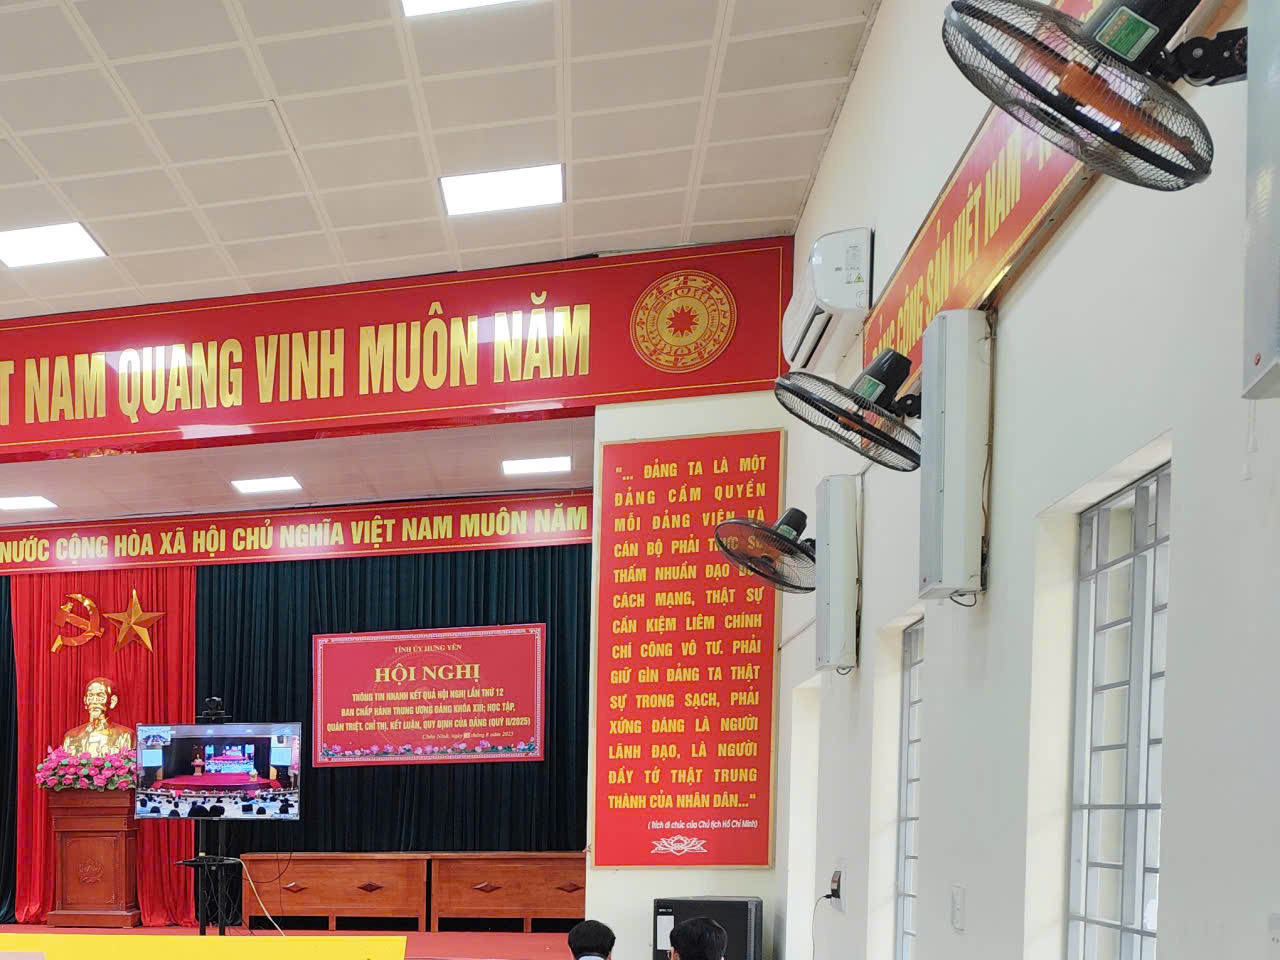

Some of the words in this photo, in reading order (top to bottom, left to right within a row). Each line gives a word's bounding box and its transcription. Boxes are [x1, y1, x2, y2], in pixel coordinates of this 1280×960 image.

[953, 182, 982, 288] VIỆT
[985, 124, 1020, 246] NAM
[25, 352, 106, 423] NAM
[119, 338, 242, 423] QUANG
[255, 329, 344, 403] VINH
[359, 302, 478, 395] MUÔN
[494, 291, 590, 383] NĂM
[644, 458, 678, 479] ĐẢNG
[688, 461, 703, 475] TA
[714, 456, 728, 473] LÀ
[740, 454, 766, 474] MỘT
[615, 486, 655, 506] ĐẢNG
[615, 513, 641, 532] MỖI
[652, 509, 690, 529] ĐẢNG
[56, 533, 108, 564] CỘNG
[115, 529, 153, 557] HÒA
[159, 528, 186, 555] XÃ
[193, 525, 225, 557] HỘI
[233, 519, 274, 550] CHỦ
[279, 519, 344, 548] NGHĨA
[351, 515, 396, 548] VIỆT
[402, 515, 452, 541] NAM
[460, 507, 528, 538] MUÔN
[534, 503, 587, 533] NĂM
[614, 541, 639, 557] CÁN
[647, 539, 663, 559] BỘ
[672, 534, 699, 554] PHẢI
[706, 564, 730, 579] ĐẠO
[613, 592, 644, 609] CÁCH
[655, 592, 695, 608] MẠNG,
[706, 589, 735, 609] THẬT
[746, 586, 765, 605] SỰ
[646, 613, 676, 635] KIỆM
[686, 613, 715, 630] LIÊM
[725, 612, 762, 629] CHÍNH
[612, 641, 632, 659] CHÍ
[640, 640, 673, 658] CÔNG
[681, 639, 696, 656] VÔ
[733, 635, 761, 654] PHẢI
[375, 664, 416, 685] HỘI
[423, 664, 480, 682] NGHỊ
[639, 666, 658, 683] GÌN
[667, 663, 699, 682] ĐẢNG
[708, 667, 722, 681] TA
[731, 665, 760, 682] THẬT
[496, 688, 503, 696] 12
[610, 694, 627, 711] SỰ
[636, 694, 674, 708] TRONG
[685, 693, 720, 710] SẠCH,
[731, 686, 759, 705] PHẢI
[652, 717, 684, 733] ĐÁNG
[695, 716, 710, 732] LÀ
[609, 743, 641, 759] LÃNH
[652, 744, 680, 761] ĐẠO,
[692, 741, 707, 758] LÀ
[644, 766, 661, 784] TỚ
[671, 767, 703, 786] THẬT
[714, 768, 757, 783] TRUNG
[608, 793, 646, 809] THÀNH
[649, 790, 673, 809] CỦA
[677, 792, 710, 808] NHÂN
